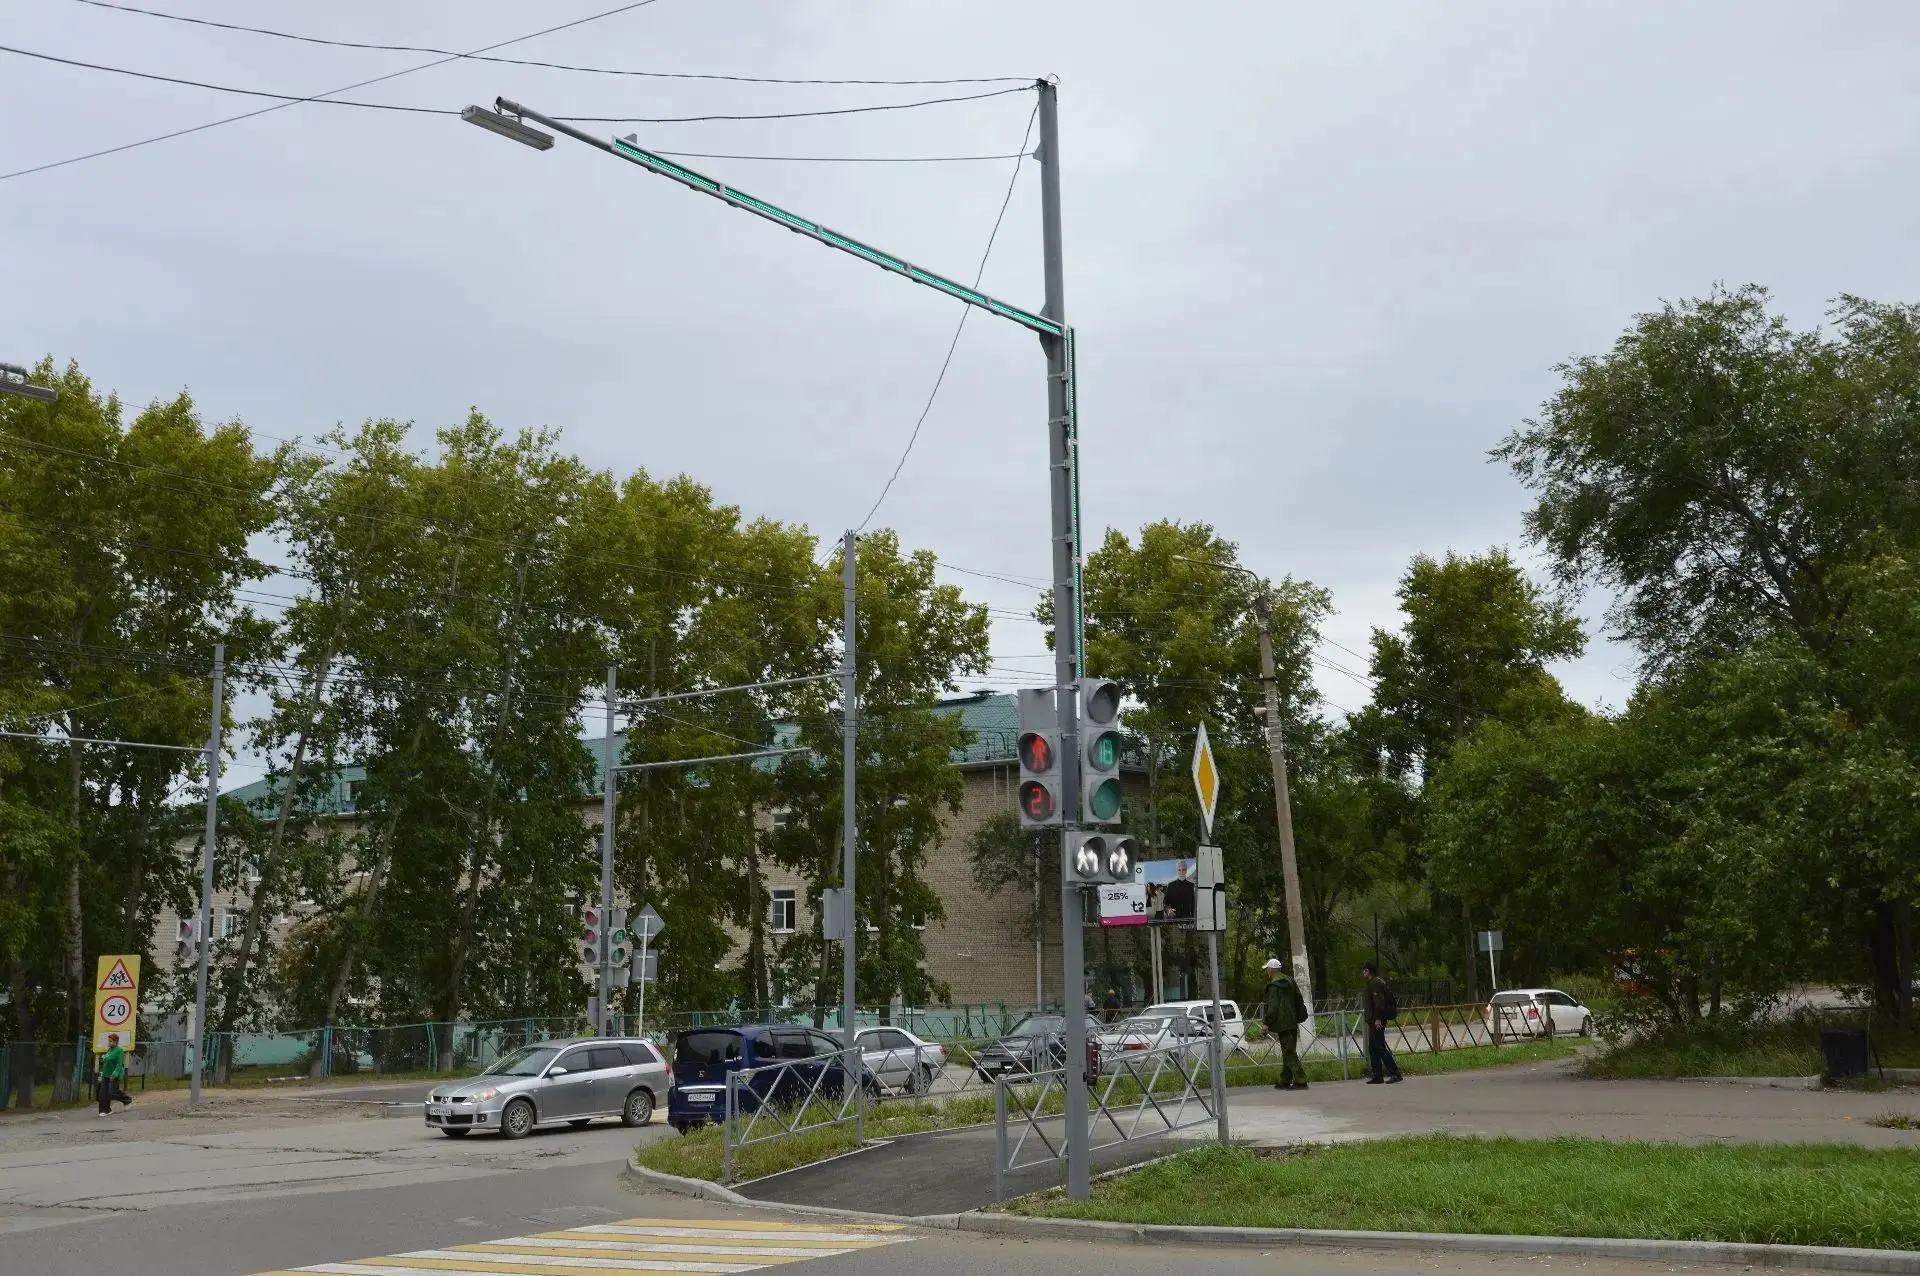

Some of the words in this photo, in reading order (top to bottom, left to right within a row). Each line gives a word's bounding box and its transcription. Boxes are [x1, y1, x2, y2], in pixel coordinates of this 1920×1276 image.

[1107, 892, 1129, 901] 25%
[1131, 901, 1145, 913] t2
[107, 1004, 126, 1017] 20
